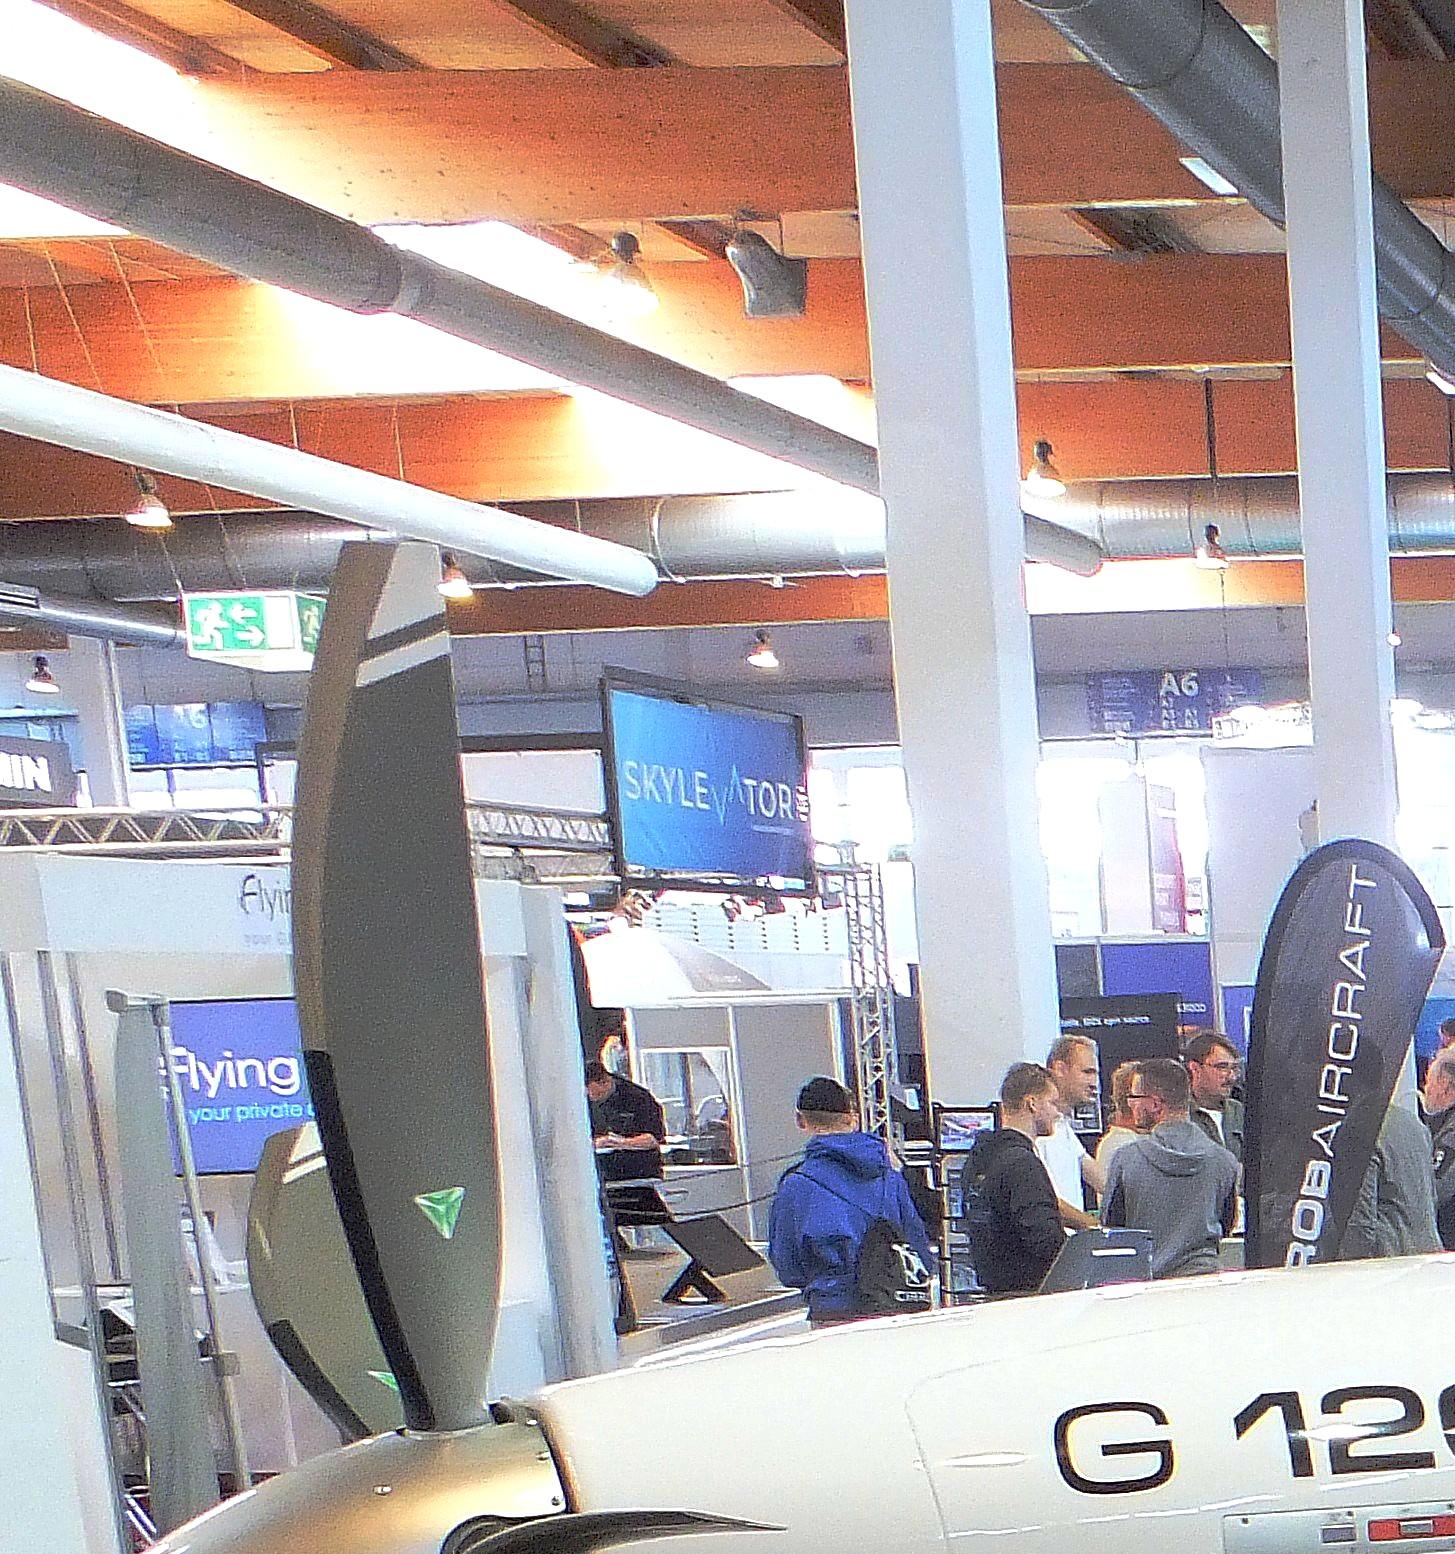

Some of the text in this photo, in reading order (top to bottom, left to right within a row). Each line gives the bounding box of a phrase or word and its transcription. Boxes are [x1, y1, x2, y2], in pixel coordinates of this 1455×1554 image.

[1160, 672, 1199, 697] A6
[1286, 864, 1378, 1271] ROB AIRCRAFT
[188, 1106, 232, 1125] your
[235, 1102, 303, 1124] private
[1054, 1400, 1175, 1495] G
